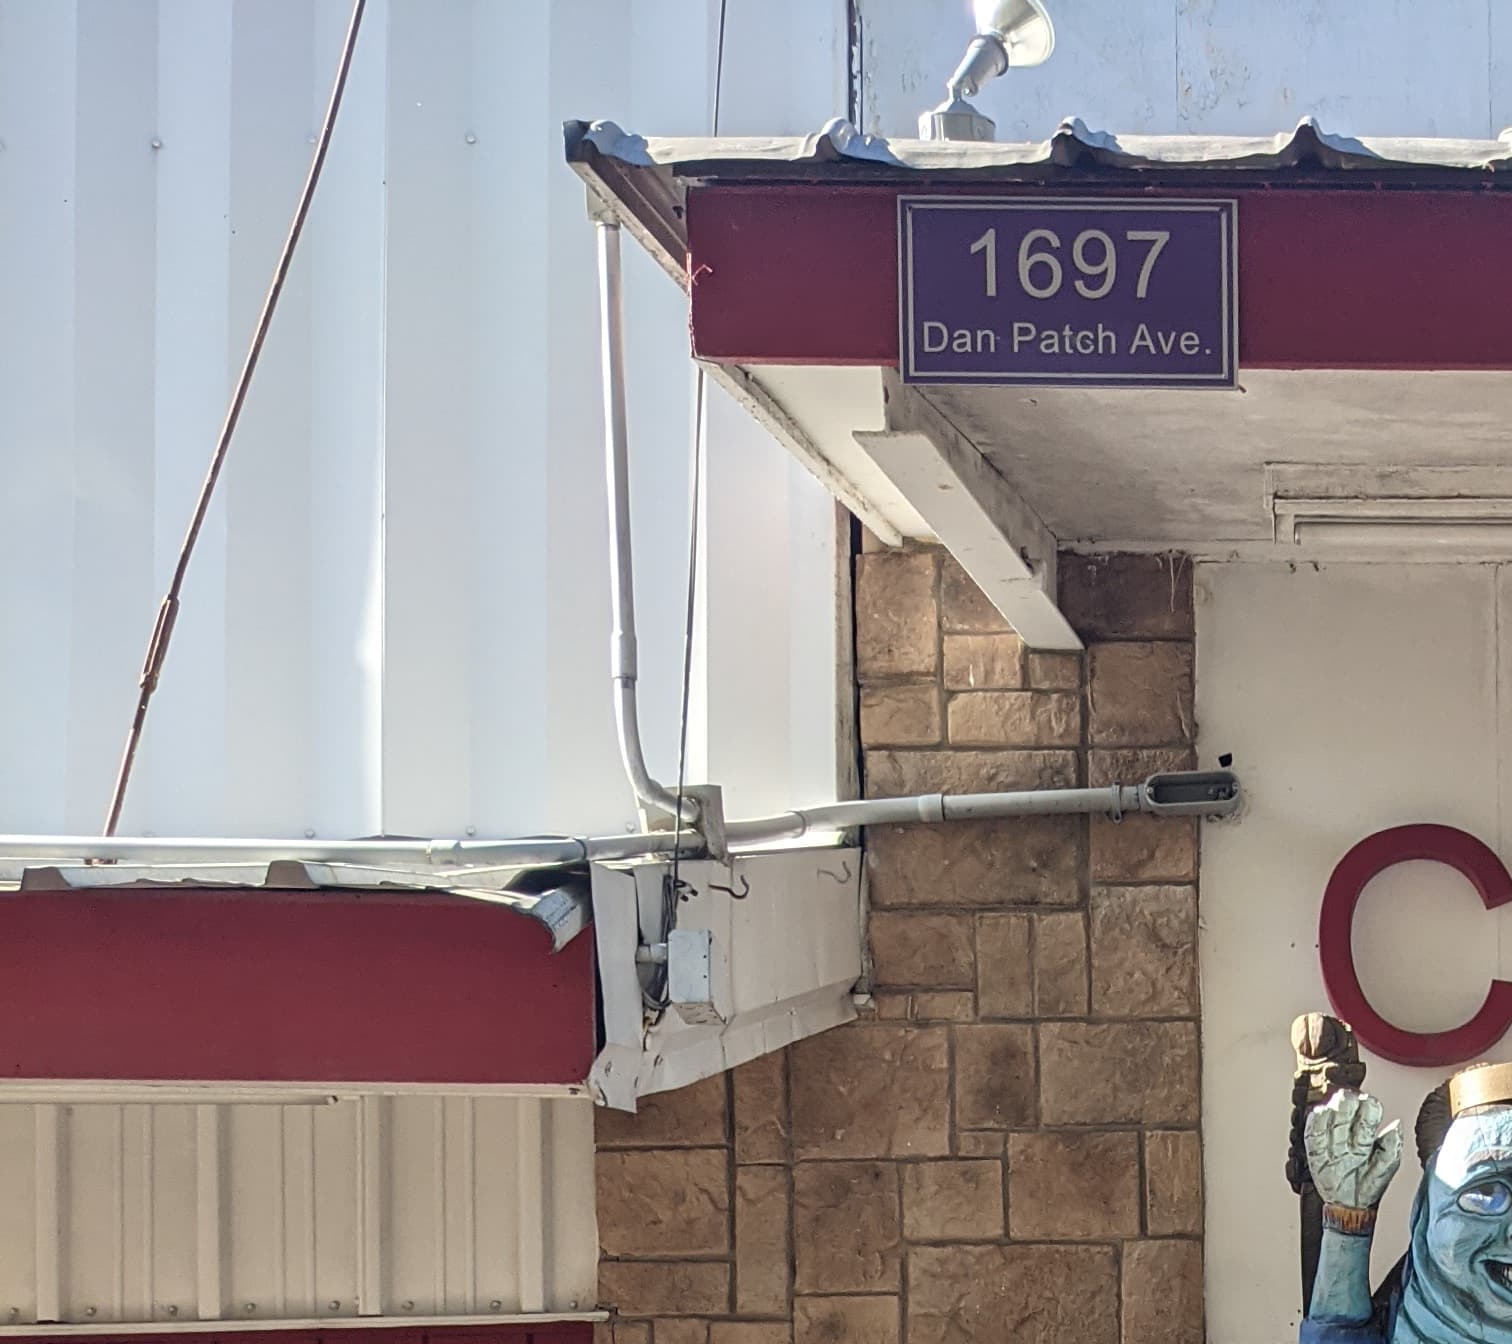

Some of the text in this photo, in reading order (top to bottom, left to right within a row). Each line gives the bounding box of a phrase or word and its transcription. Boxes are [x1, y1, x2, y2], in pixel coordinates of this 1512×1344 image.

[969, 227, 1171, 300] 1697
[922, 320, 1213, 355] Dan Patch Ave.
